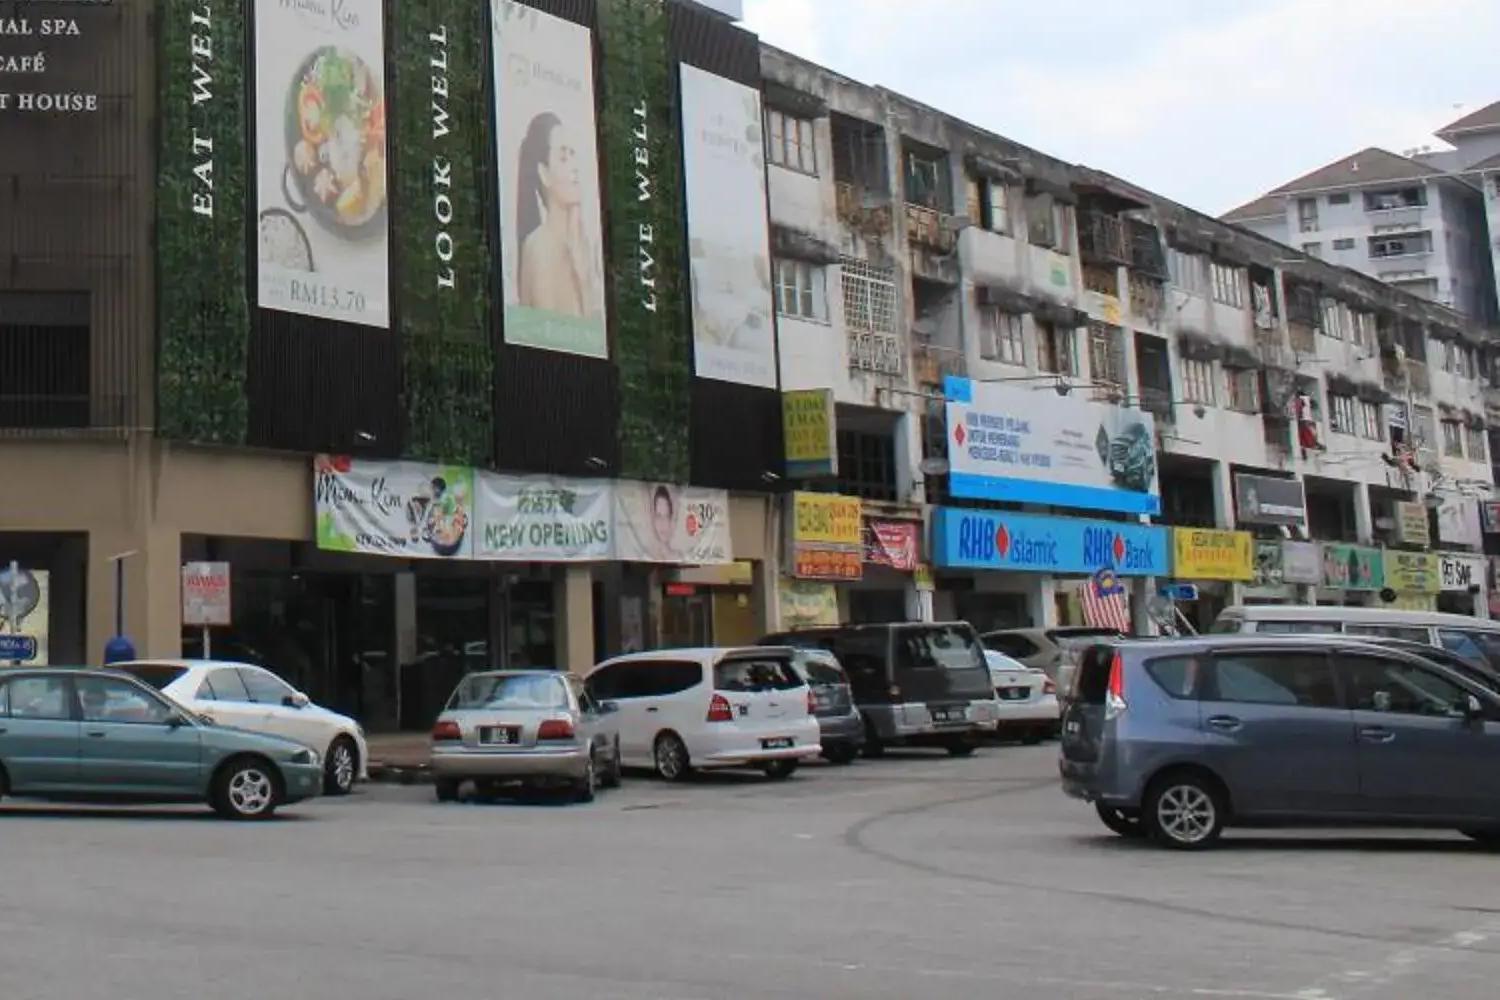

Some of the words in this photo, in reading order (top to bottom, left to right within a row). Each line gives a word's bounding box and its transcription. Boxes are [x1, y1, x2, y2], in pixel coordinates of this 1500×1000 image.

[40, 18, 81, 35] SPA
[18, 94, 98, 111] HOUSE
[429, 24, 451, 140] WELL
[191, 127, 214, 218] EAT
[632, 99, 652, 202] WELL
[432, 155, 456, 290] LOOK
[638, 223, 658, 313] LIVE
[484, 522, 526, 550] NEW
[529, 519, 608, 547] OPENING
[959, 515, 995, 561] RHB
[1009, 530, 1059, 566] Islamic
[1083, 525, 1114, 568] RHB
[1124, 539, 1155, 569] Bank
